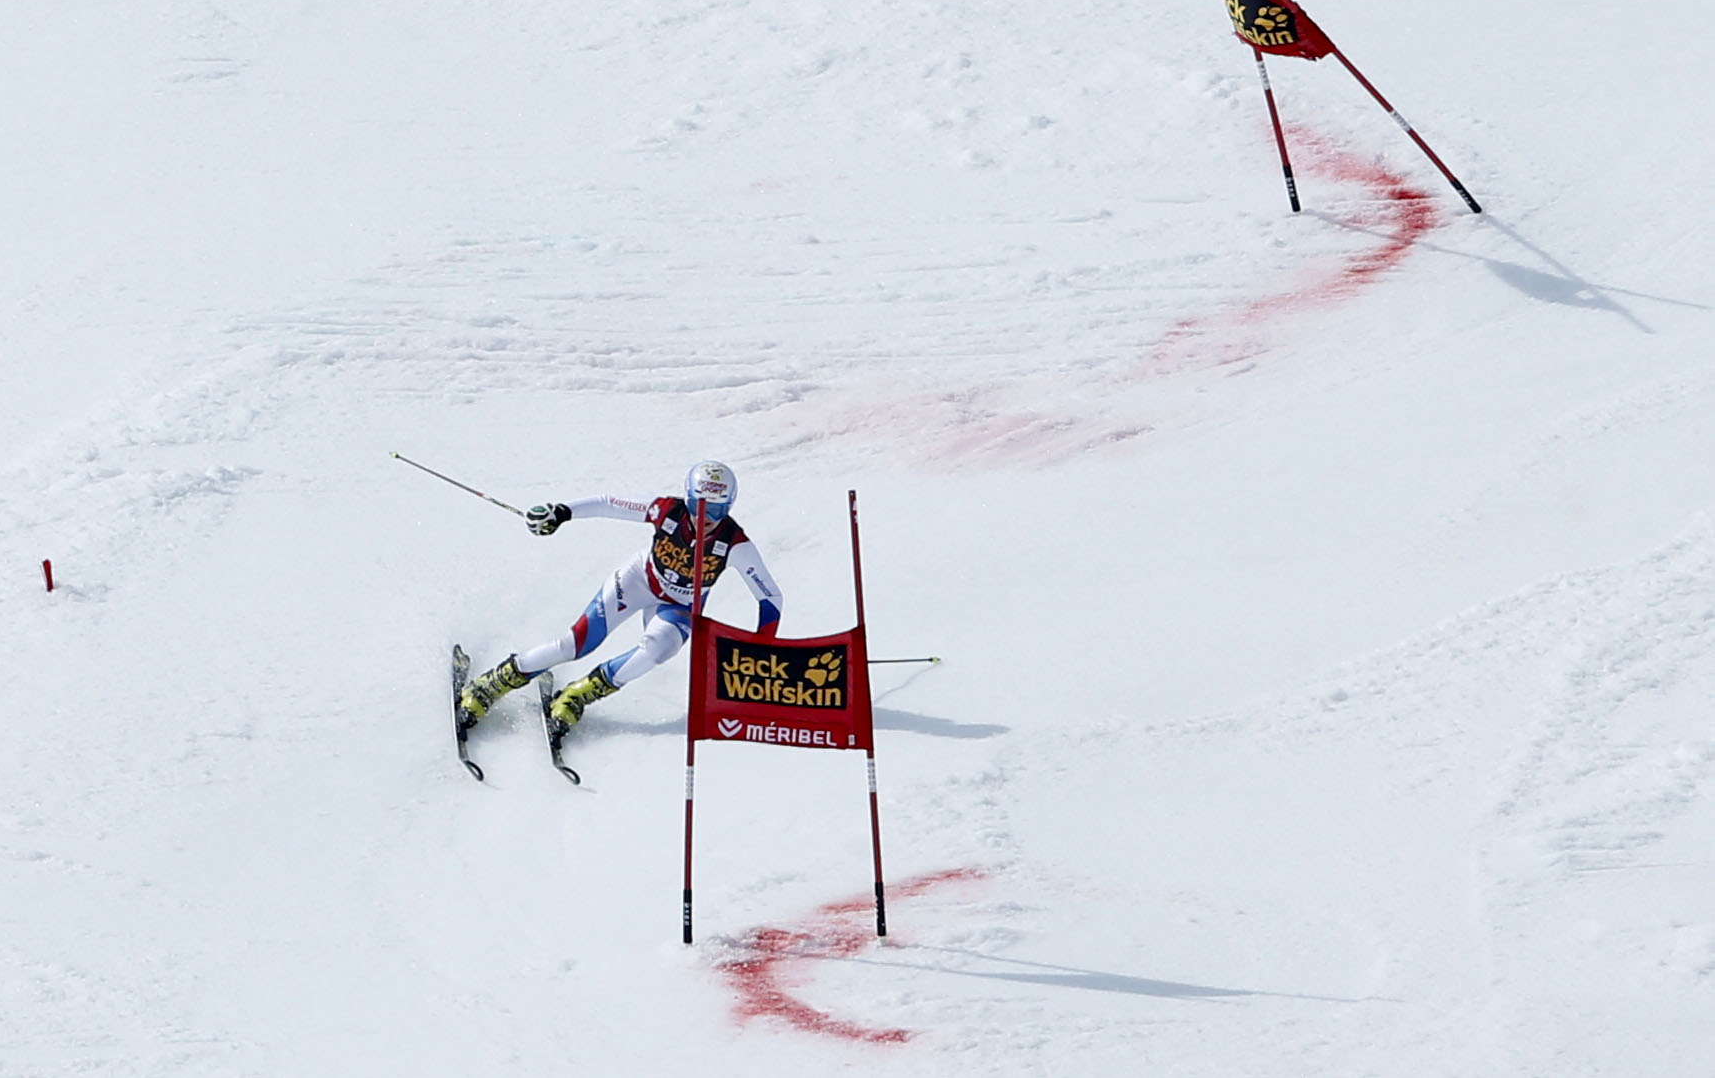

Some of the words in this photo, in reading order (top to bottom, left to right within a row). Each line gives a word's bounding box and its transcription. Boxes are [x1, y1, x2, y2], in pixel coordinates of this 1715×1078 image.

[658, 536, 690, 564] Jack
[722, 648, 789, 679] Jack
[723, 672, 842, 706] Wolfskin
[746, 722, 837, 746] MÉRIBEL
